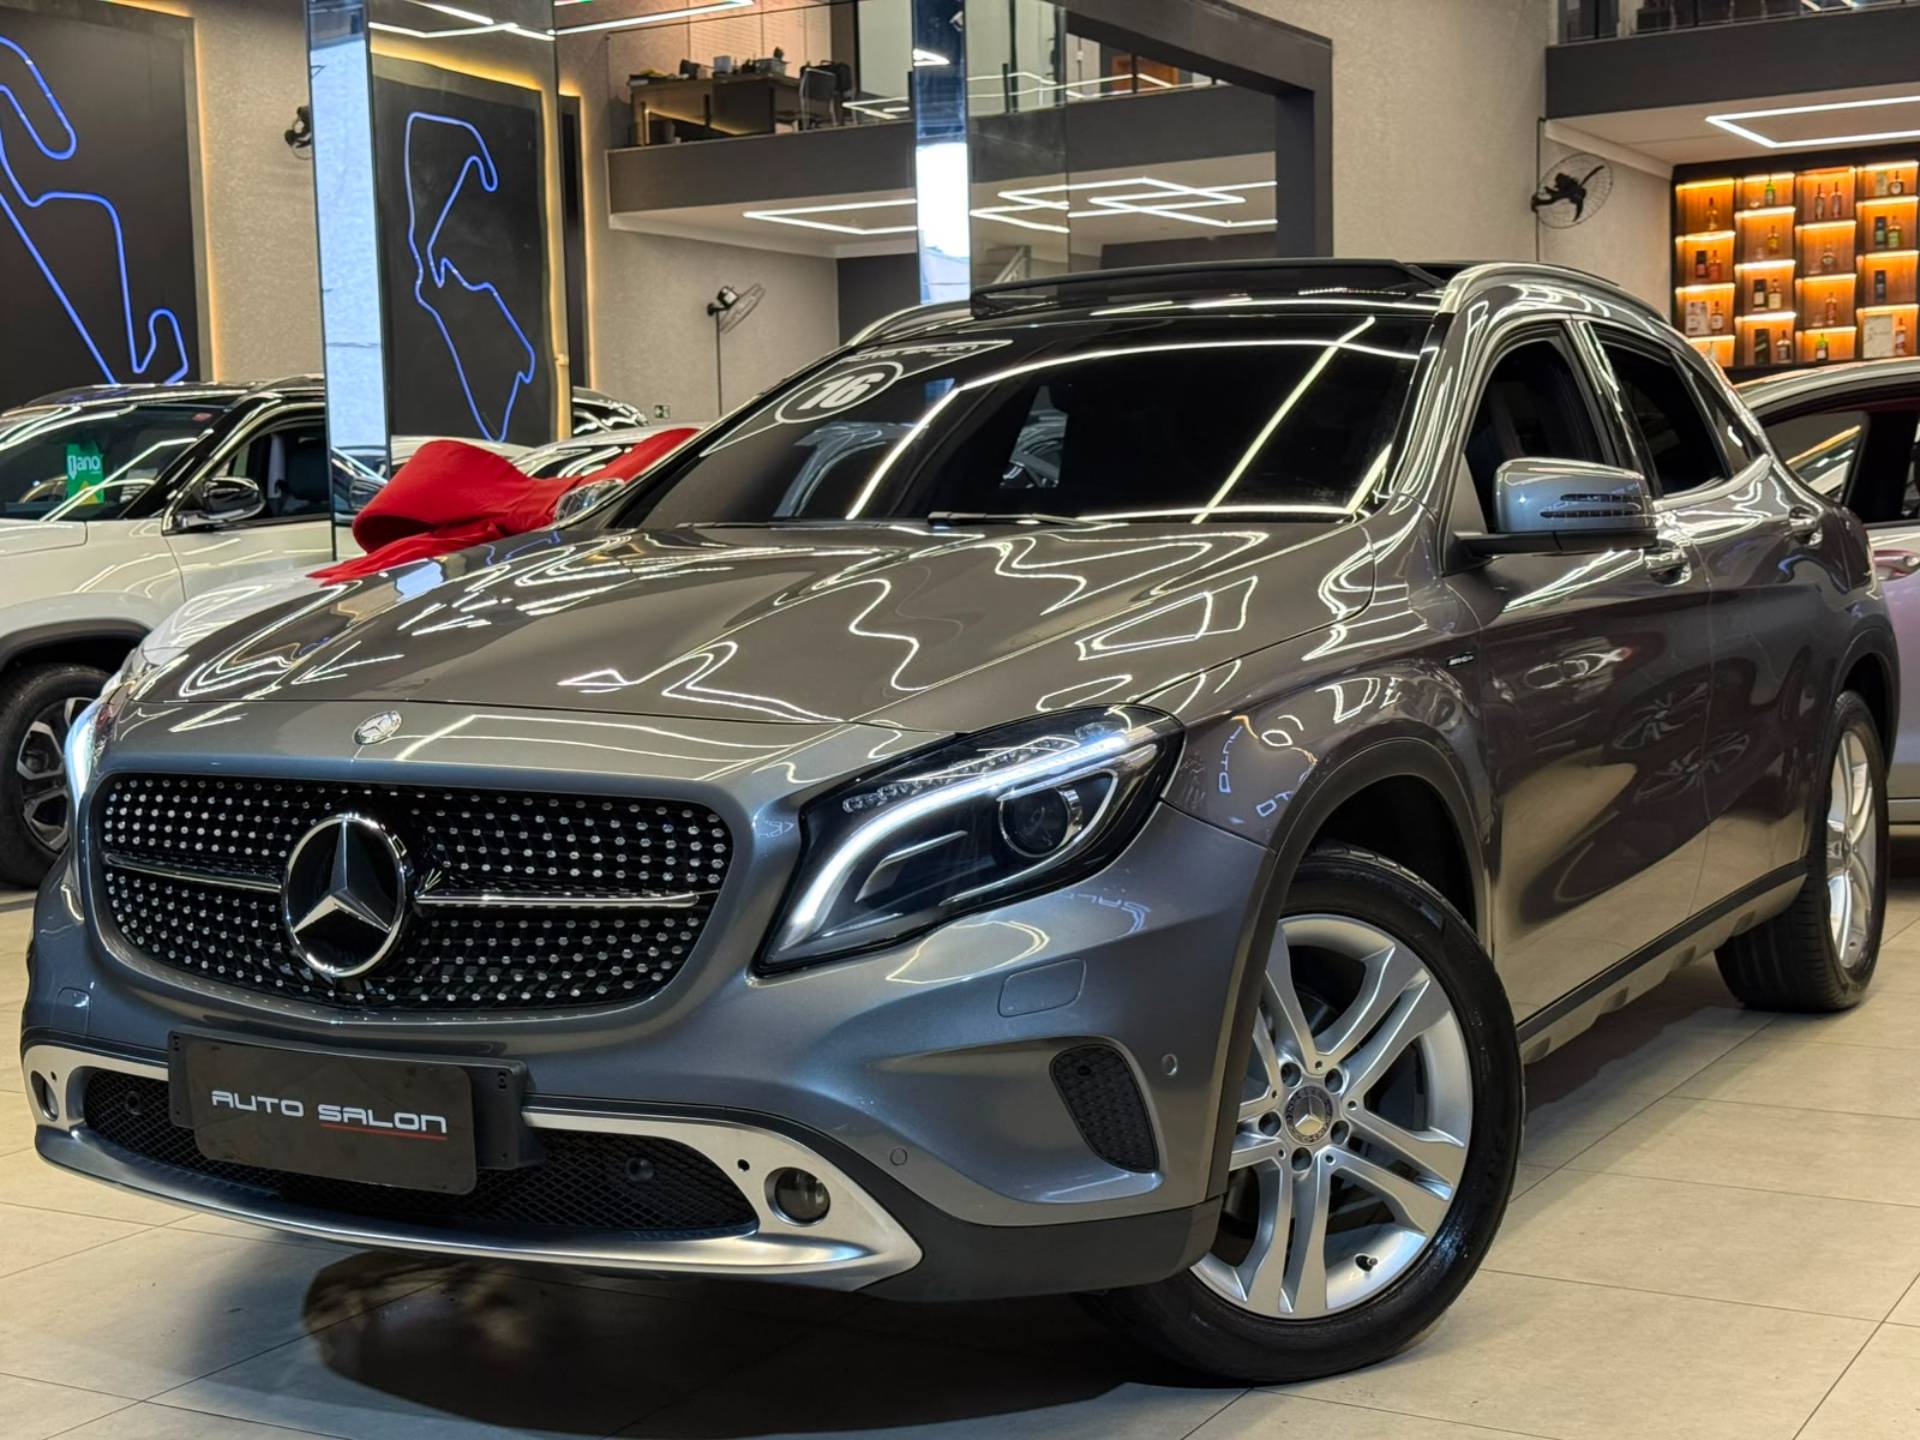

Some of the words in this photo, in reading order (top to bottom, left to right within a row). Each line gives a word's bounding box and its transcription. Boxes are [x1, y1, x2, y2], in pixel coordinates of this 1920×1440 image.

[797, 372, 885, 410] 16
[211, 1090, 304, 1117] AUTO
[317, 1104, 447, 1133] SALON
